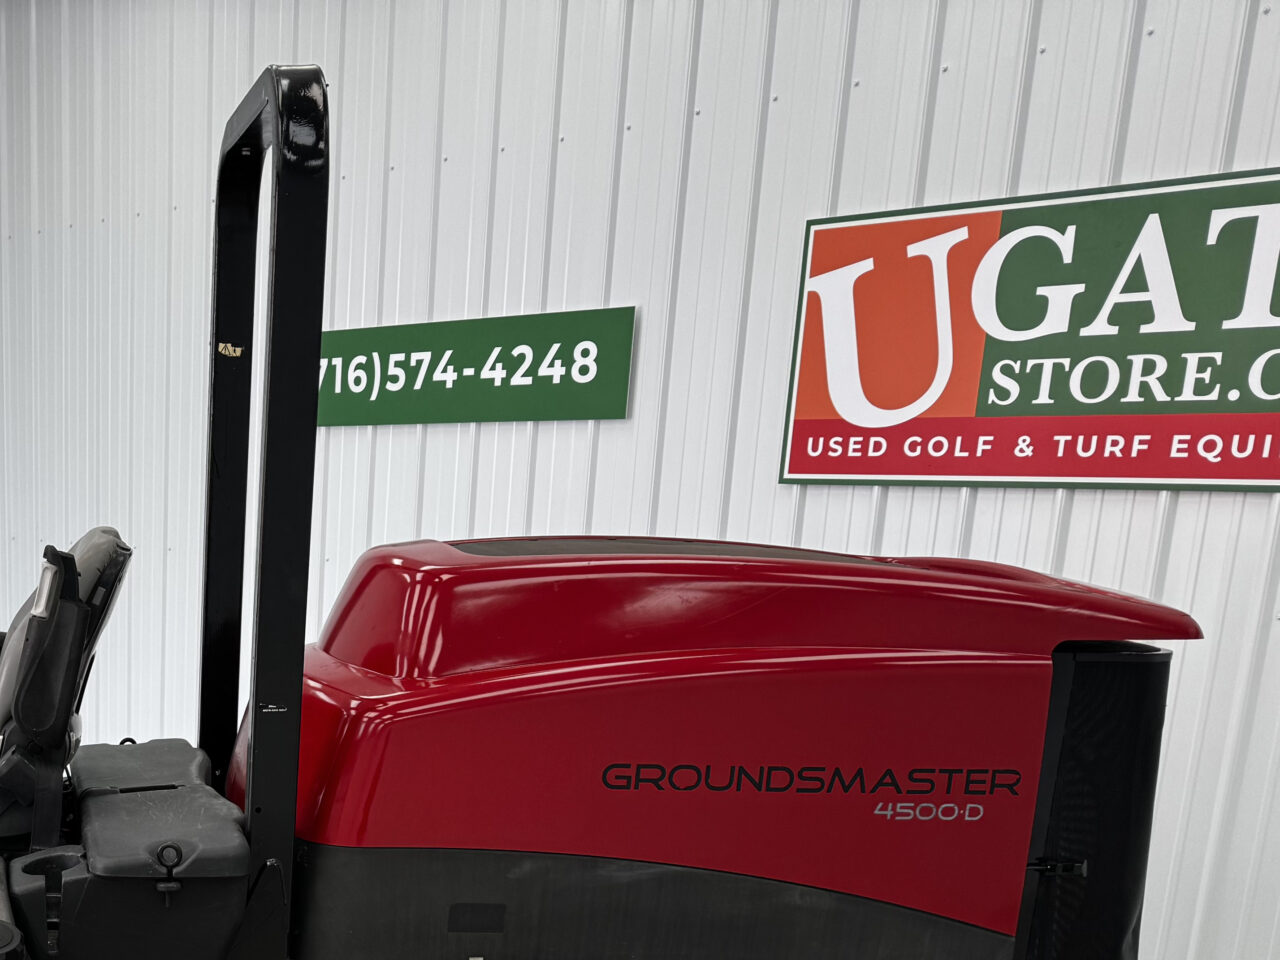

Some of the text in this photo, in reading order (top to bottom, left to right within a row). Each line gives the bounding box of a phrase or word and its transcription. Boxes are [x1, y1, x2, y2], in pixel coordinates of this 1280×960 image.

[807, 436, 887, 457] USED
[903, 435, 994, 457] GOLF
[1013, 435, 1034, 458] &
[1053, 435, 1152, 458] TURF
[601, 763, 1022, 797] GROUNDSMASTER
